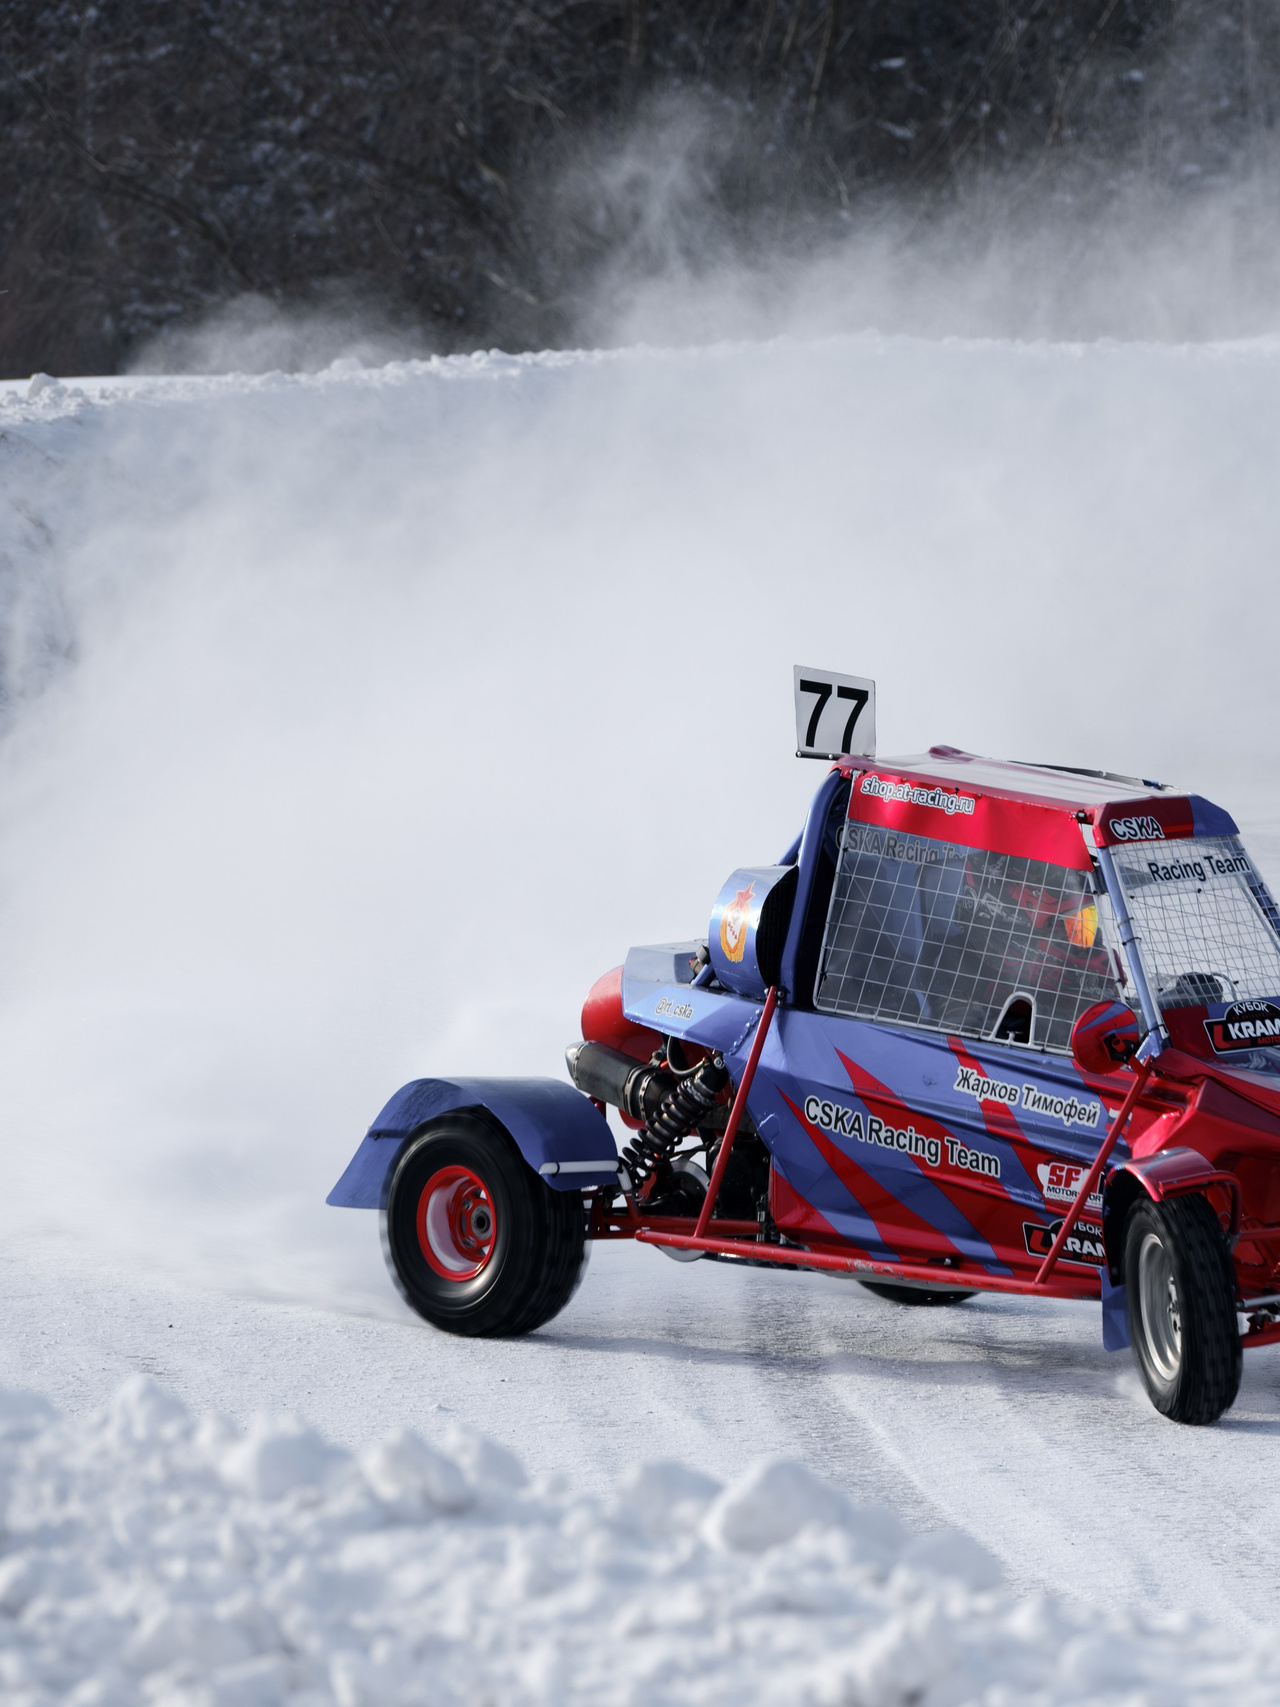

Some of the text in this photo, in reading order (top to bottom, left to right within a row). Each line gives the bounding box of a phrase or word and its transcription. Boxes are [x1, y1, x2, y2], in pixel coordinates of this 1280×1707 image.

[799, 678, 869, 755] 77
[861, 776, 975, 814] shop.at-racing.ru
[1110, 816, 1164, 840] CSKA
[1147, 855, 1251, 882] Racing Team
[1232, 1001, 1270, 1016] КУБОК
[956, 1068, 1099, 1125] Жарков Тимофей
[805, 1097, 1001, 1176] CSKA Racing Team
